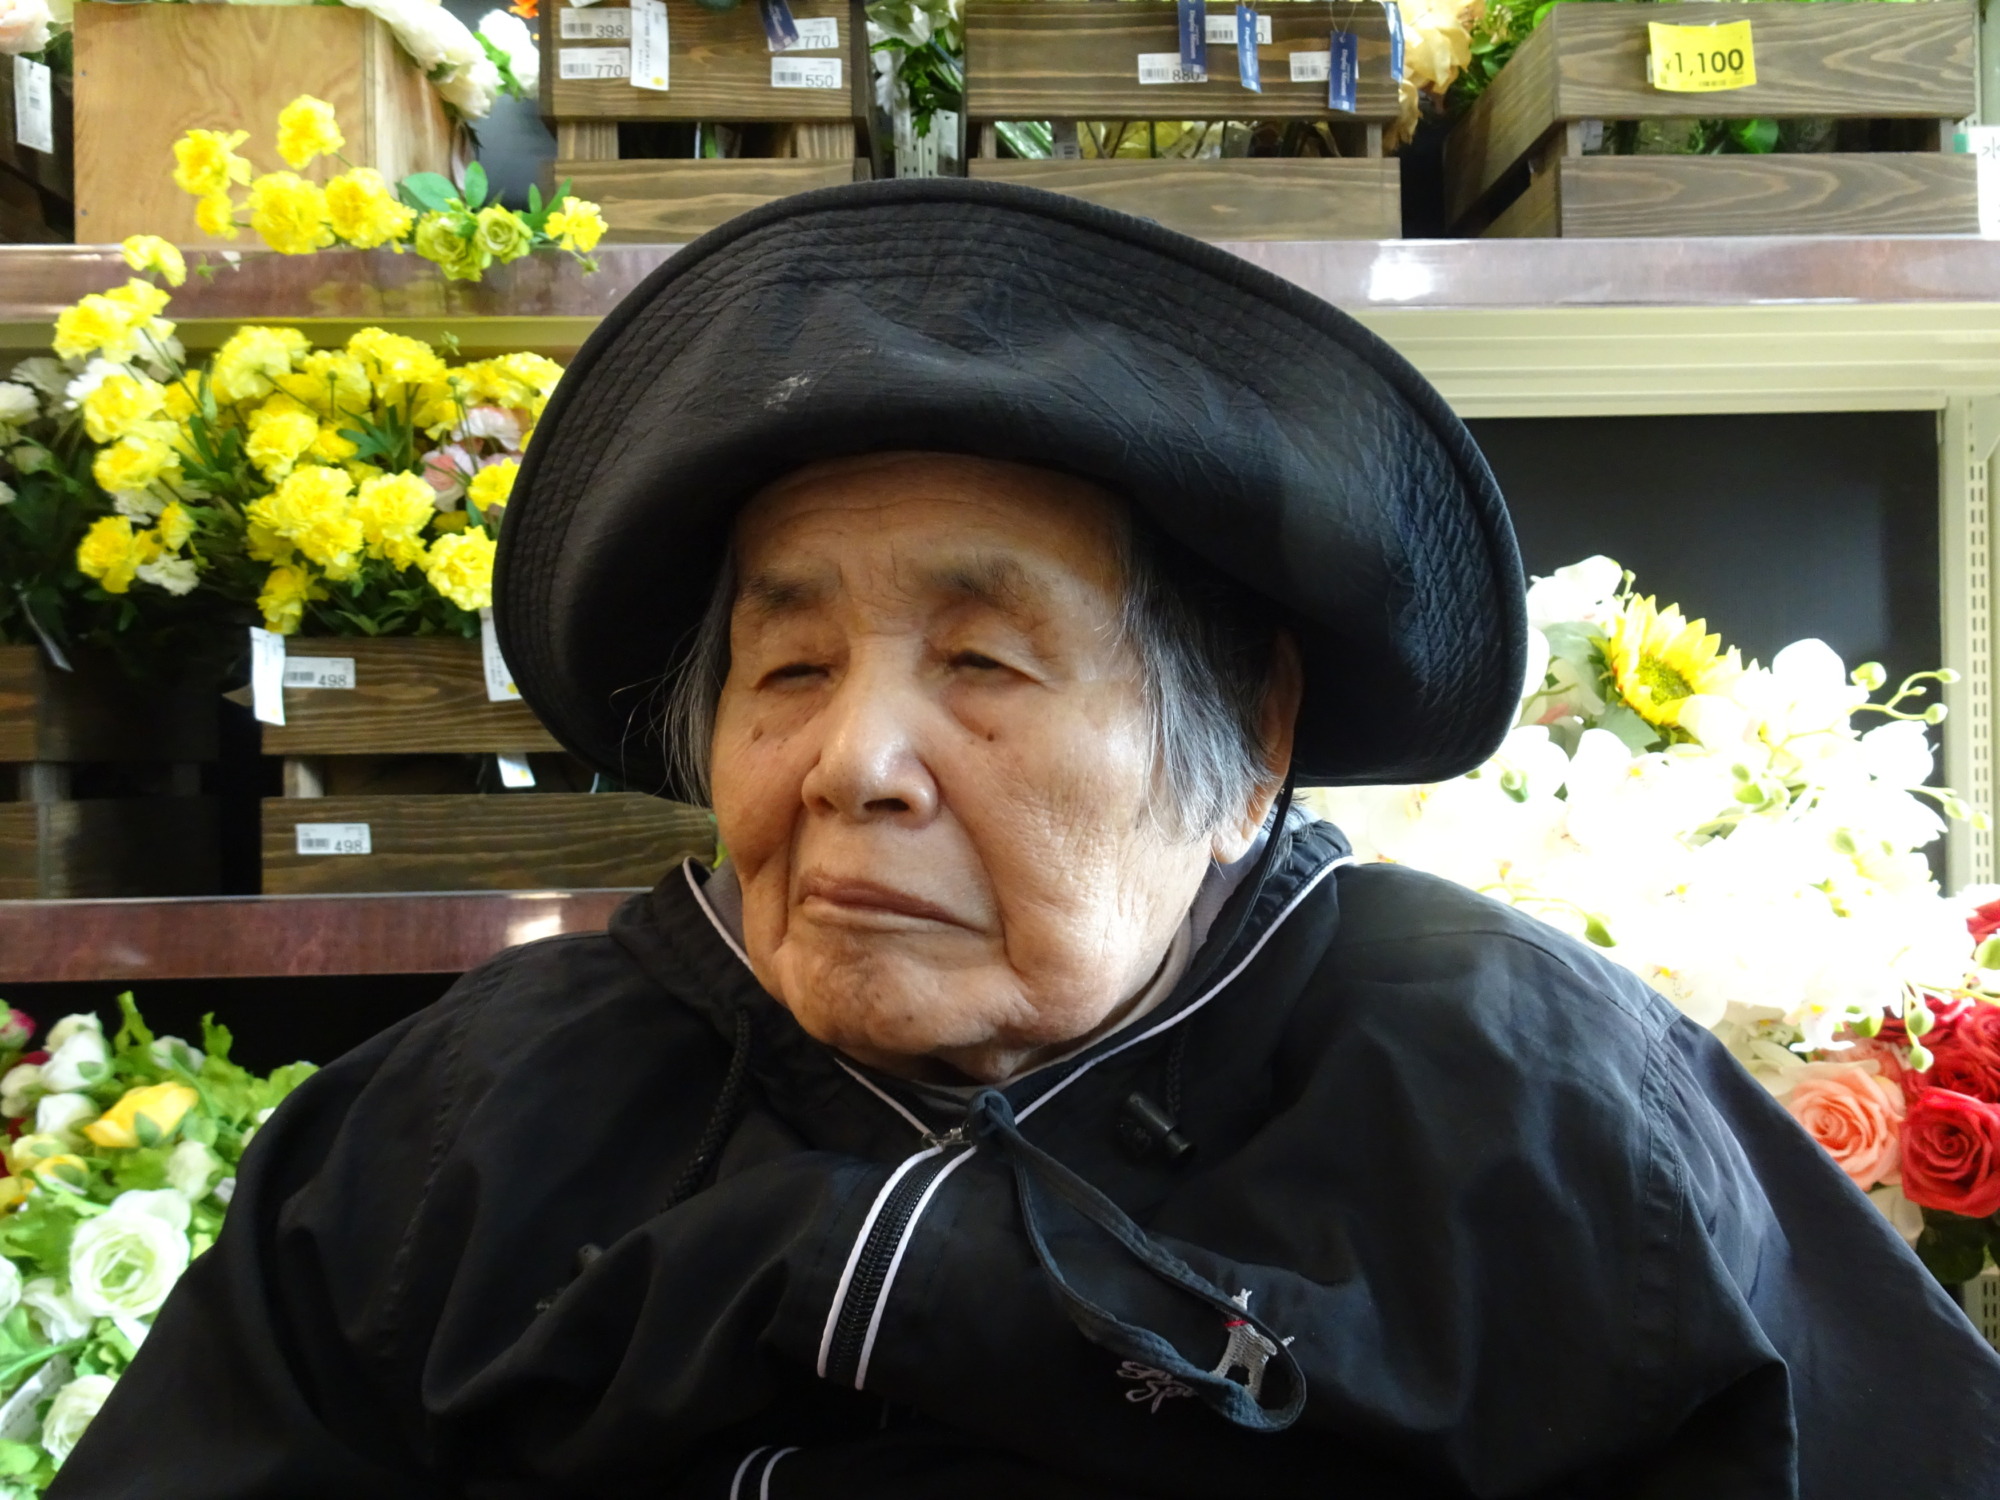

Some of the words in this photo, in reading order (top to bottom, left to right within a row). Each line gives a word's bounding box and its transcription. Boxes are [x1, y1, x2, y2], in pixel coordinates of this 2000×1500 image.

[595, 24, 625, 38] 398
[802, 35, 831, 49] 770
[595, 64, 624, 78] 770
[805, 74, 834, 88] 550
[317, 674, 347, 687] 498
[333, 840, 363, 853] 498
